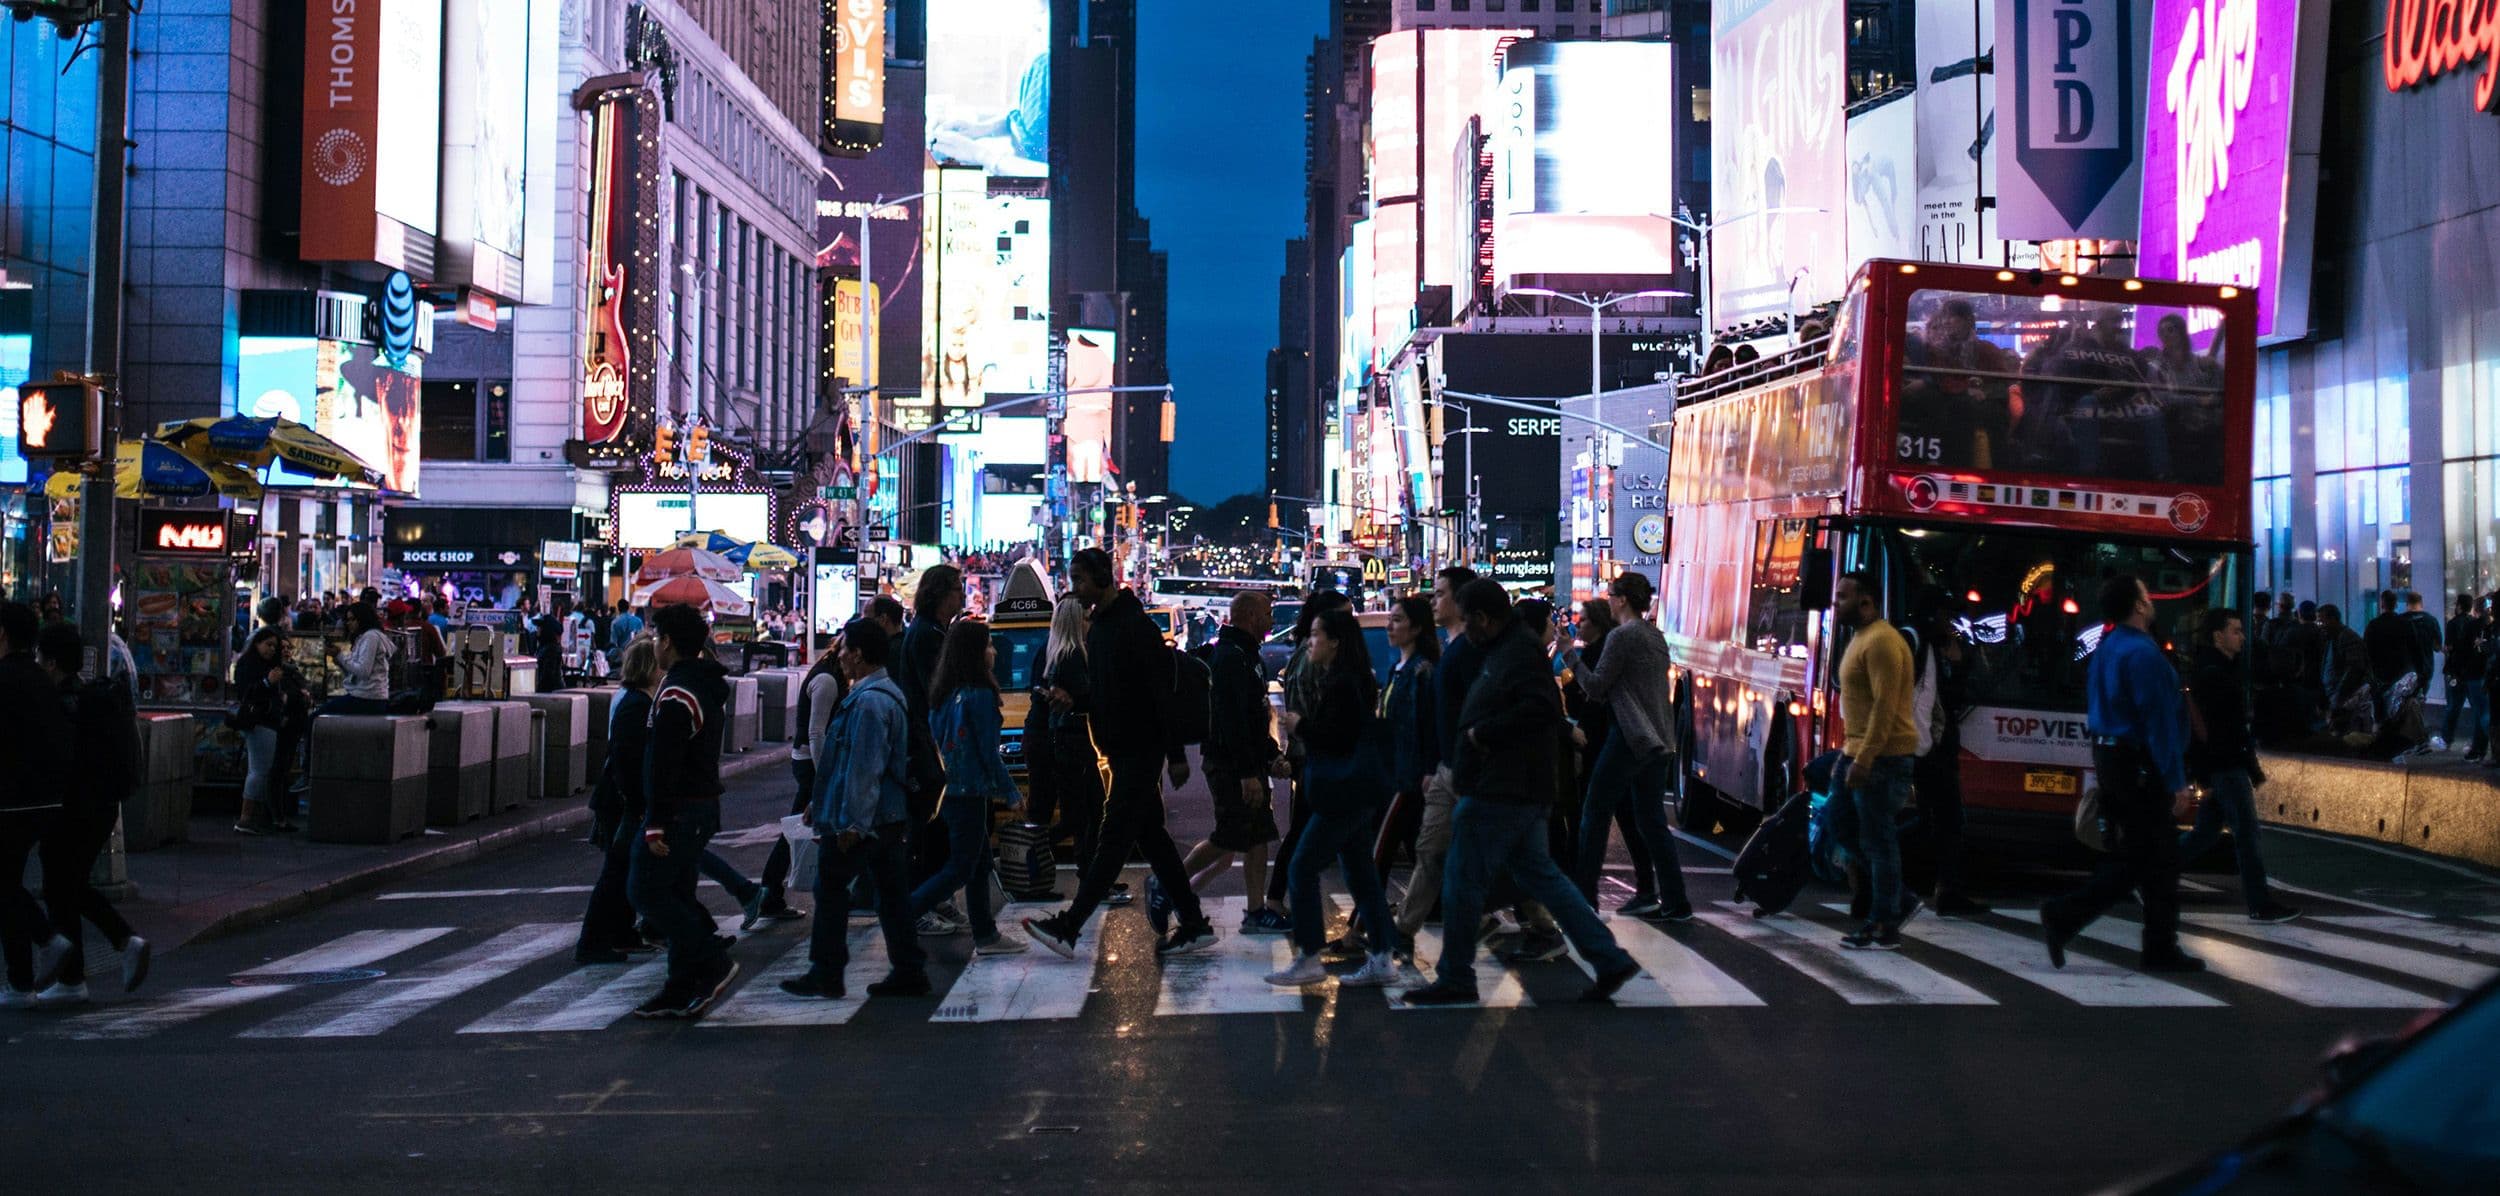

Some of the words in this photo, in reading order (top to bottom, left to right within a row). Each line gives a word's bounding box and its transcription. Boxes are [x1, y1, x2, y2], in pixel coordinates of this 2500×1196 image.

[1924, 201, 1946, 210] meet
[1930, 212, 1939, 220] in
[1941, 211, 1956, 219] the
[1922, 222, 1965, 264] GAP
[1508, 418, 1561, 436] SERPE
[1899, 435, 1941, 460] 315
[287, 446, 342, 471] SABRETT
[827, 488, 835, 497] W
[837, 487, 848, 497] 43
[403, 551, 437, 563] ROCK
[439, 551, 475, 563] SHOP
[1494, 560, 1548, 577] sunglass
[1011, 600, 1038, 610] 4C66
